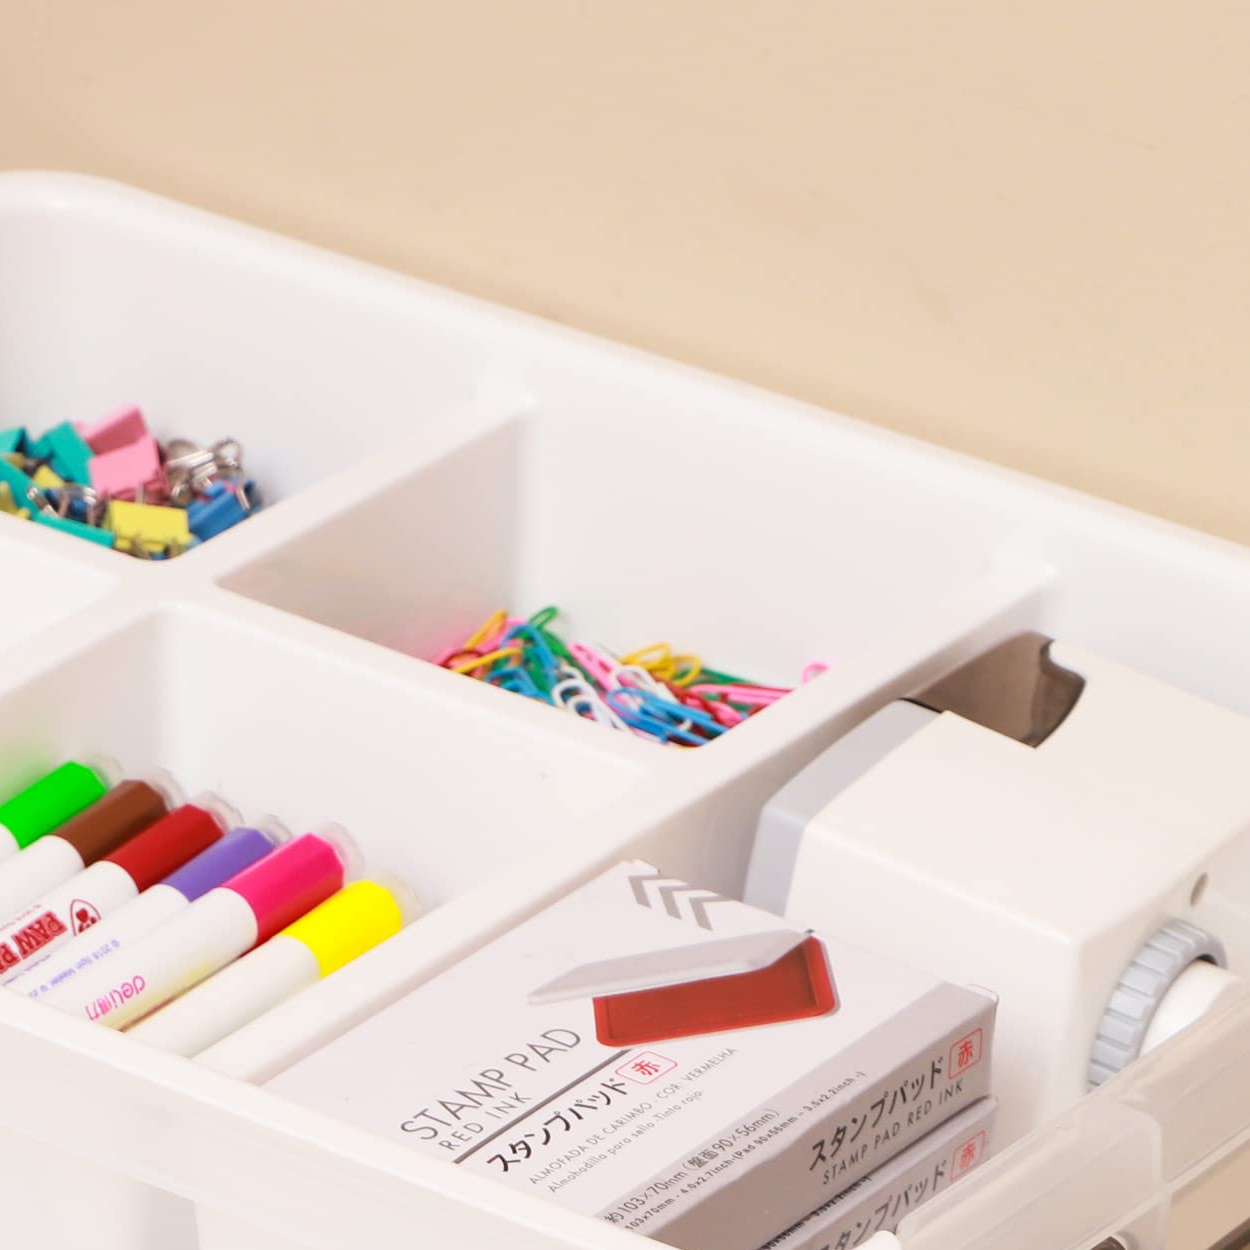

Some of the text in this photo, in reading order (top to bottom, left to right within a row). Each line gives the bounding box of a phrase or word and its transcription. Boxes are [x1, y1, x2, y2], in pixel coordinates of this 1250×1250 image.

[11, 909, 69, 960] PAW
[400, 1028, 582, 1140] STAMP PAD
[438, 1091, 533, 1151] RED INK
[486, 1060, 661, 1172] スタンプパッド 赤
[529, 1145, 589, 1184] ALMOFADA
[586, 1133, 605, 1145] DE
[602, 1102, 652, 1135] CARIMBO
[681, 1047, 738, 1082] VERMELHA
[809, 1039, 974, 1171] スタンプパッド 赤
[822, 1078, 964, 1185] STAMP PAD RED INK
[549, 1153, 607, 1192] Almohadilla
[607, 1137, 632, 1156] para
[631, 1121, 655, 1138] sello
